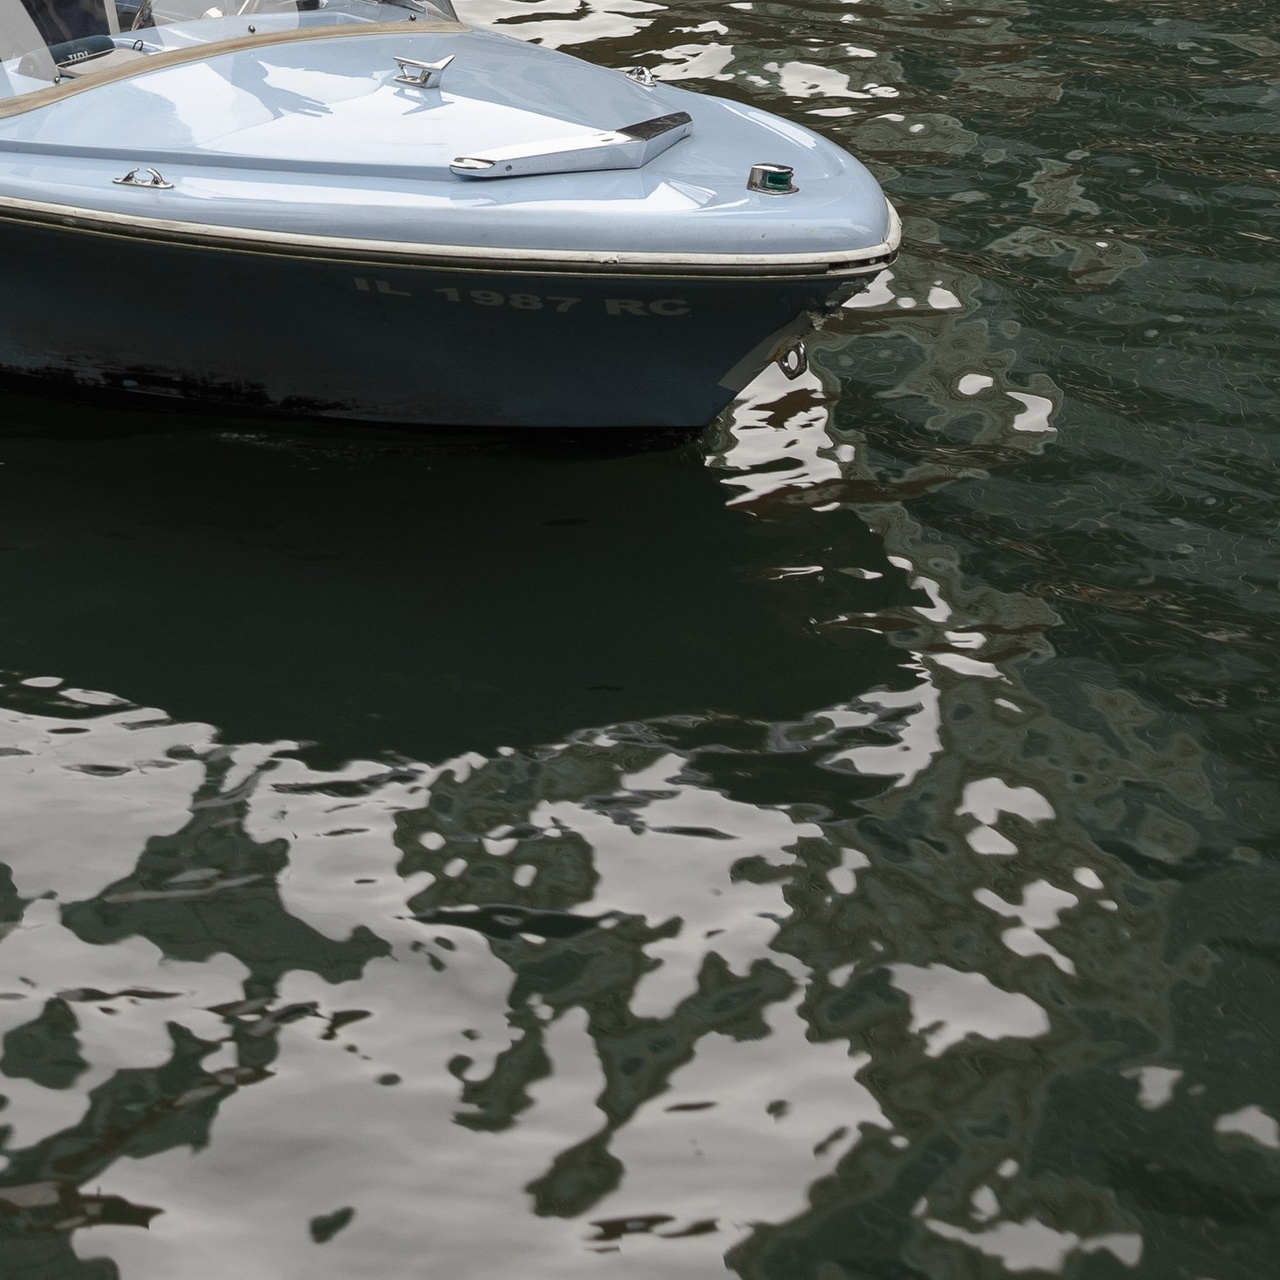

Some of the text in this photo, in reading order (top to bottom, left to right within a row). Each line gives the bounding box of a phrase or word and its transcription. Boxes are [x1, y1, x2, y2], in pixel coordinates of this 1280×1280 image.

[353, 276, 691, 316] IL 1987 RC
